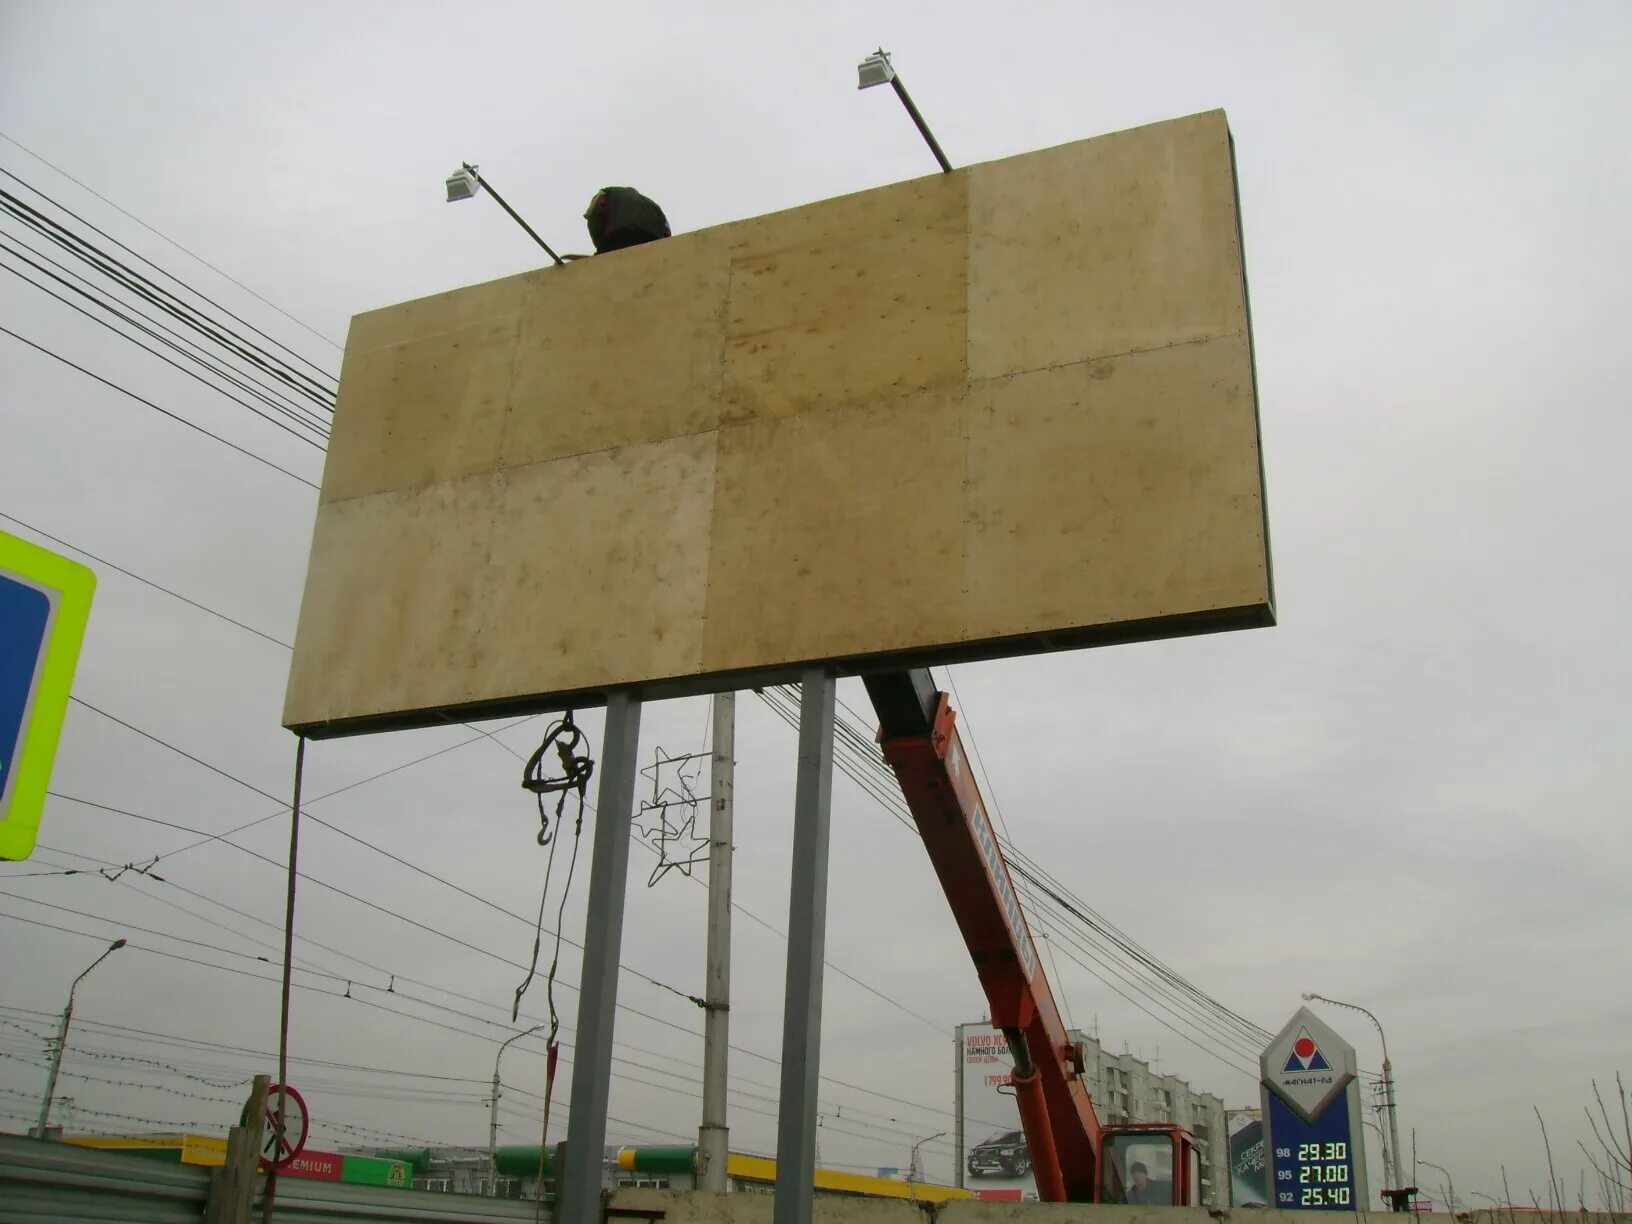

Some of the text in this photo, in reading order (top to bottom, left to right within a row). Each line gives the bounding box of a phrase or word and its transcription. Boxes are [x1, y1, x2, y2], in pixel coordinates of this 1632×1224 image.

[967, 1035, 991, 1047] VOLVO
[966, 1046, 996, 1056] НАМНОГО
[1276, 1142, 1346, 1160] 98 29.30
[287, 1159, 332, 1173] EMIUM
[1278, 1165, 1348, 1183] 95 27.00
[1279, 1187, 1350, 1206] 92 25.40
